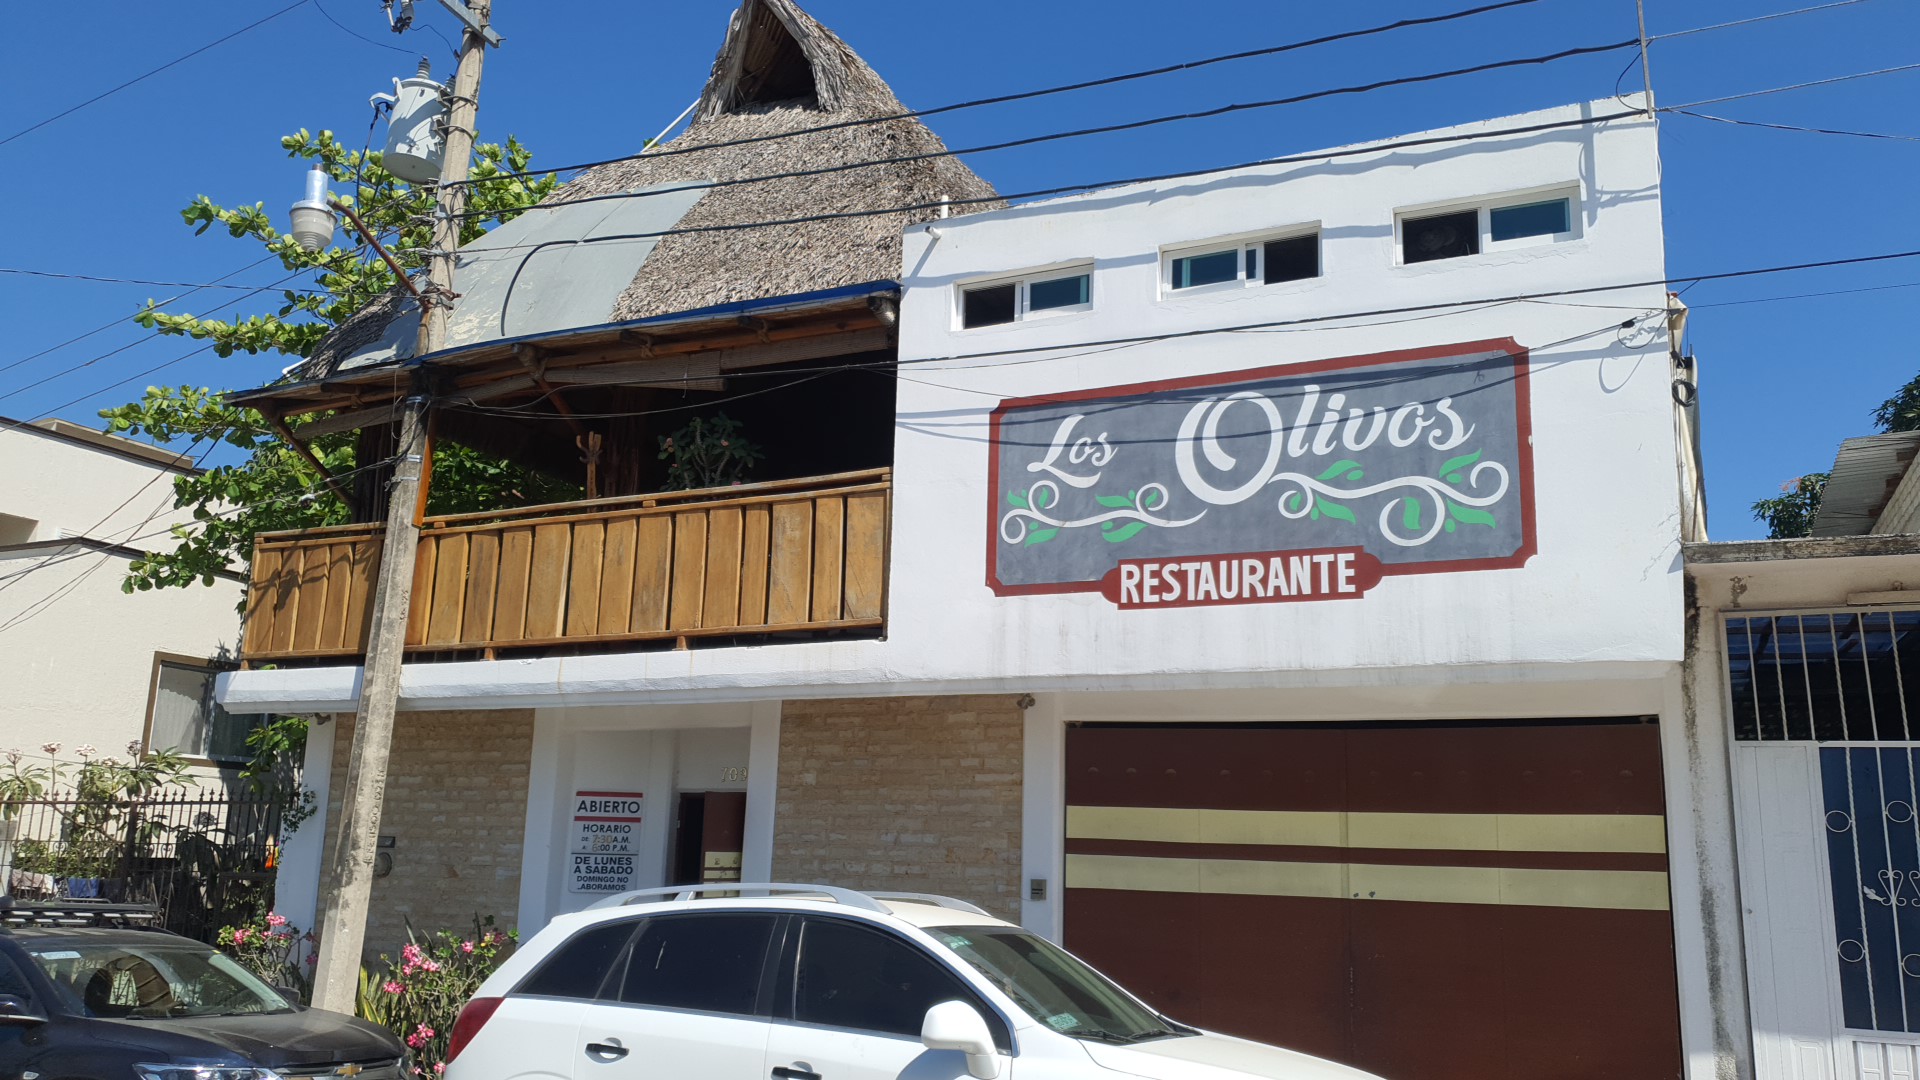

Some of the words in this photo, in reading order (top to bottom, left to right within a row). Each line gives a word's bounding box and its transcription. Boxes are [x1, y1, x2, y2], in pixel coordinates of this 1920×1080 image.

[1027, 413, 1118, 489] Los
[1174, 384, 1476, 506] Olivos
[1119, 552, 1357, 604] RESTAURANTE
[721, 767, 748, 782] 709
[577, 800, 640, 813] ABIERTO
[582, 824, 631, 833] HORARIO
[575, 856, 591, 865] DE
[594, 856, 632, 866] LUNES
[574, 865, 582, 874] A
[585, 866, 633, 875] SABADO
